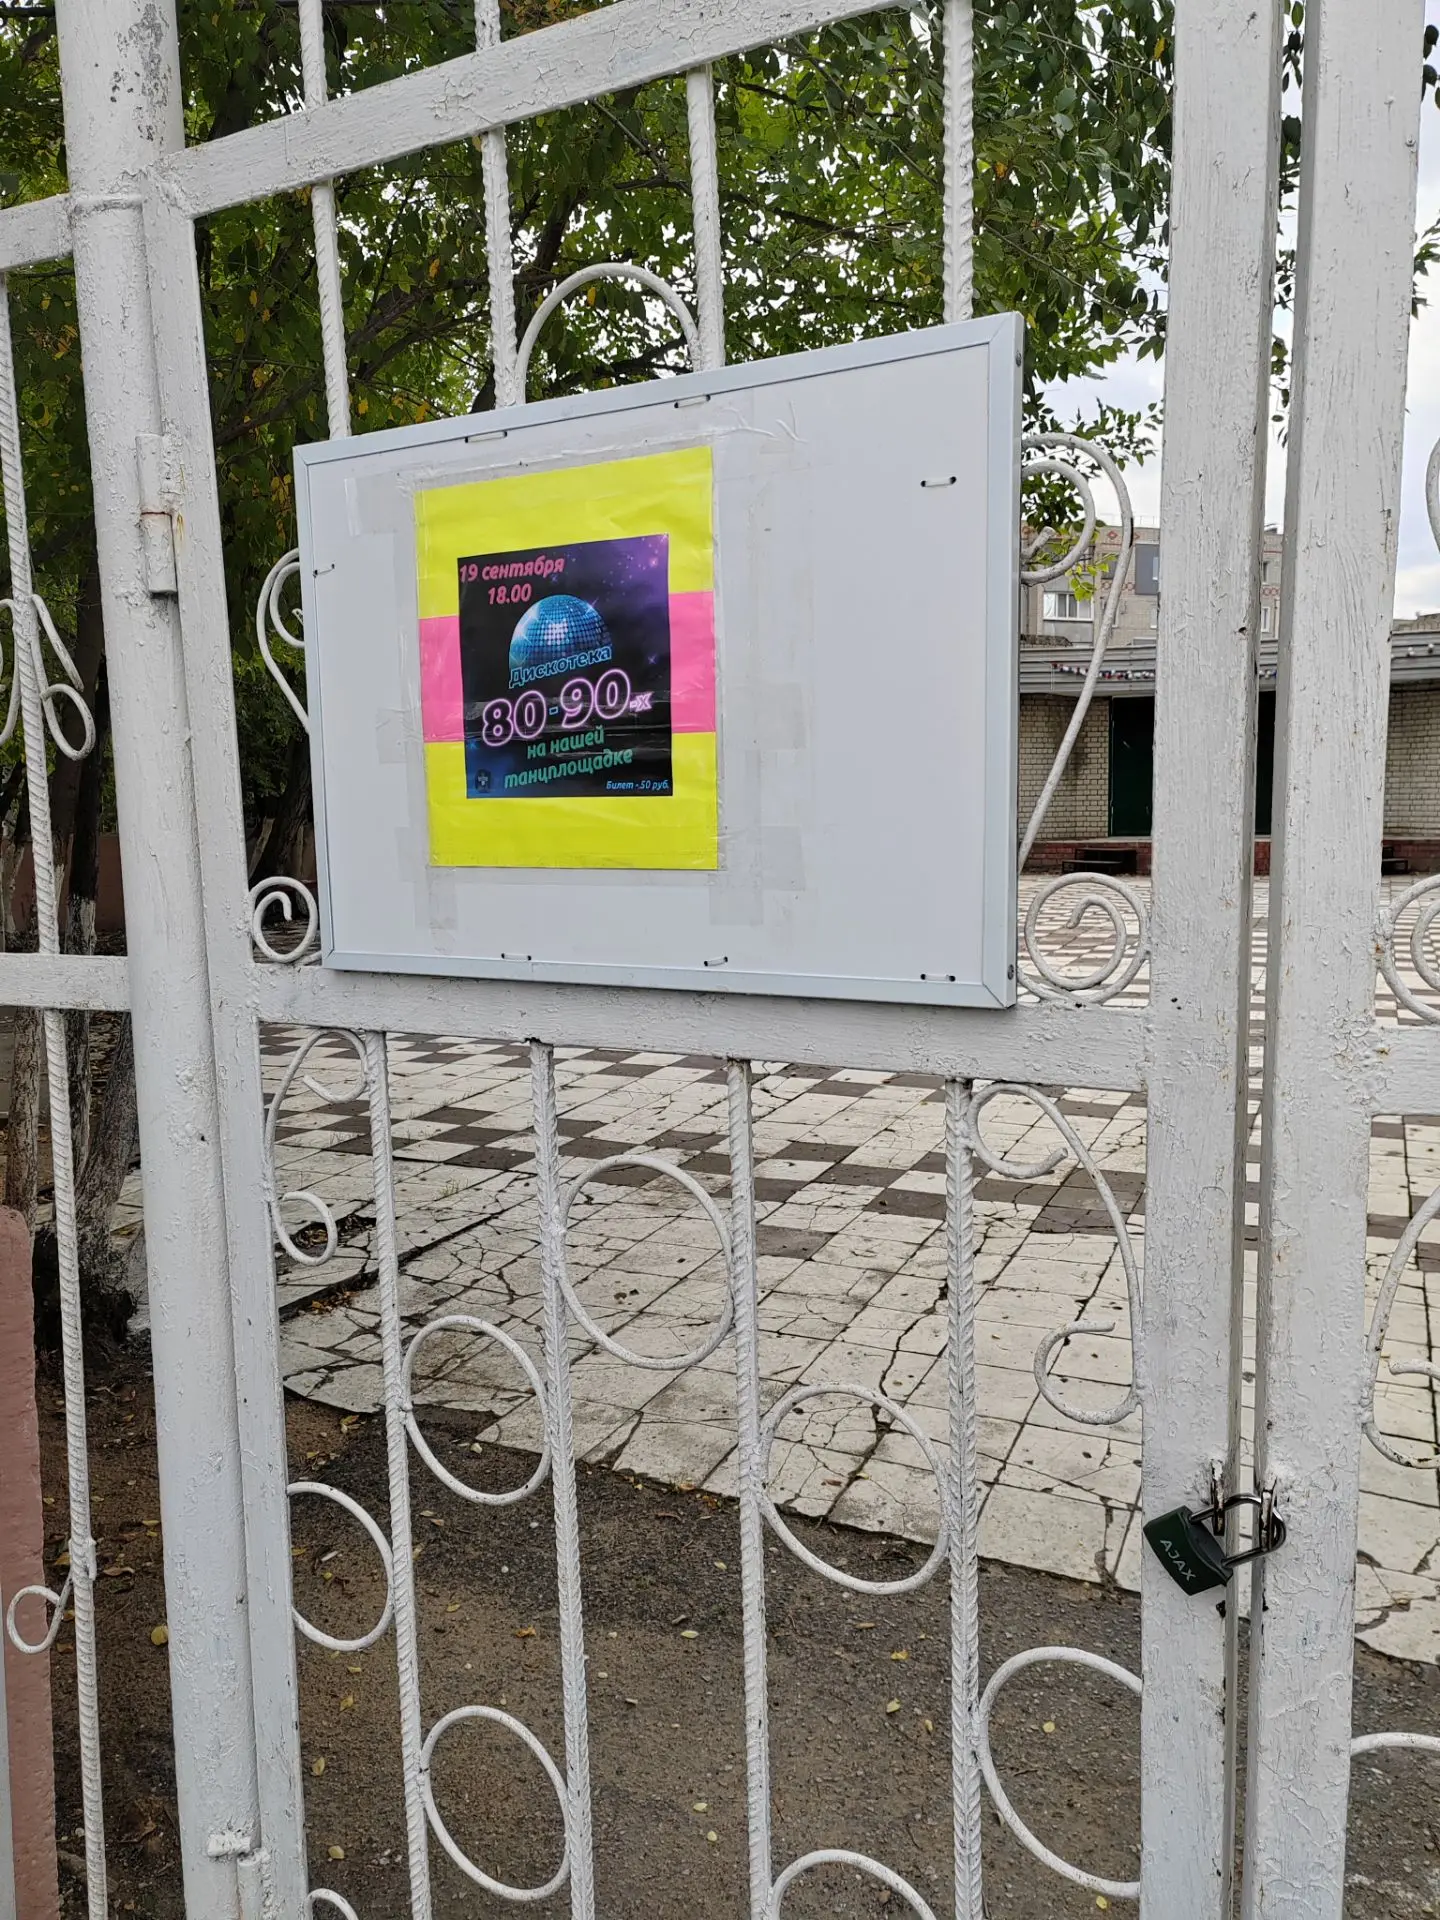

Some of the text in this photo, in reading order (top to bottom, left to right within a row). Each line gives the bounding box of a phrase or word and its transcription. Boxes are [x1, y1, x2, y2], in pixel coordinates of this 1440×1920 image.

[459, 556, 564, 582] 19 сентября
[488, 583, 532, 605] 18.00
[509, 645, 613, 689] Дискотека
[528, 726, 605, 759] на нашей
[505, 748, 634, 789] танцплощадке
[606, 780, 633, 790] Билет
[641, 780, 652, 789] 50
[1160, 1540, 1196, 1581] AJAX
